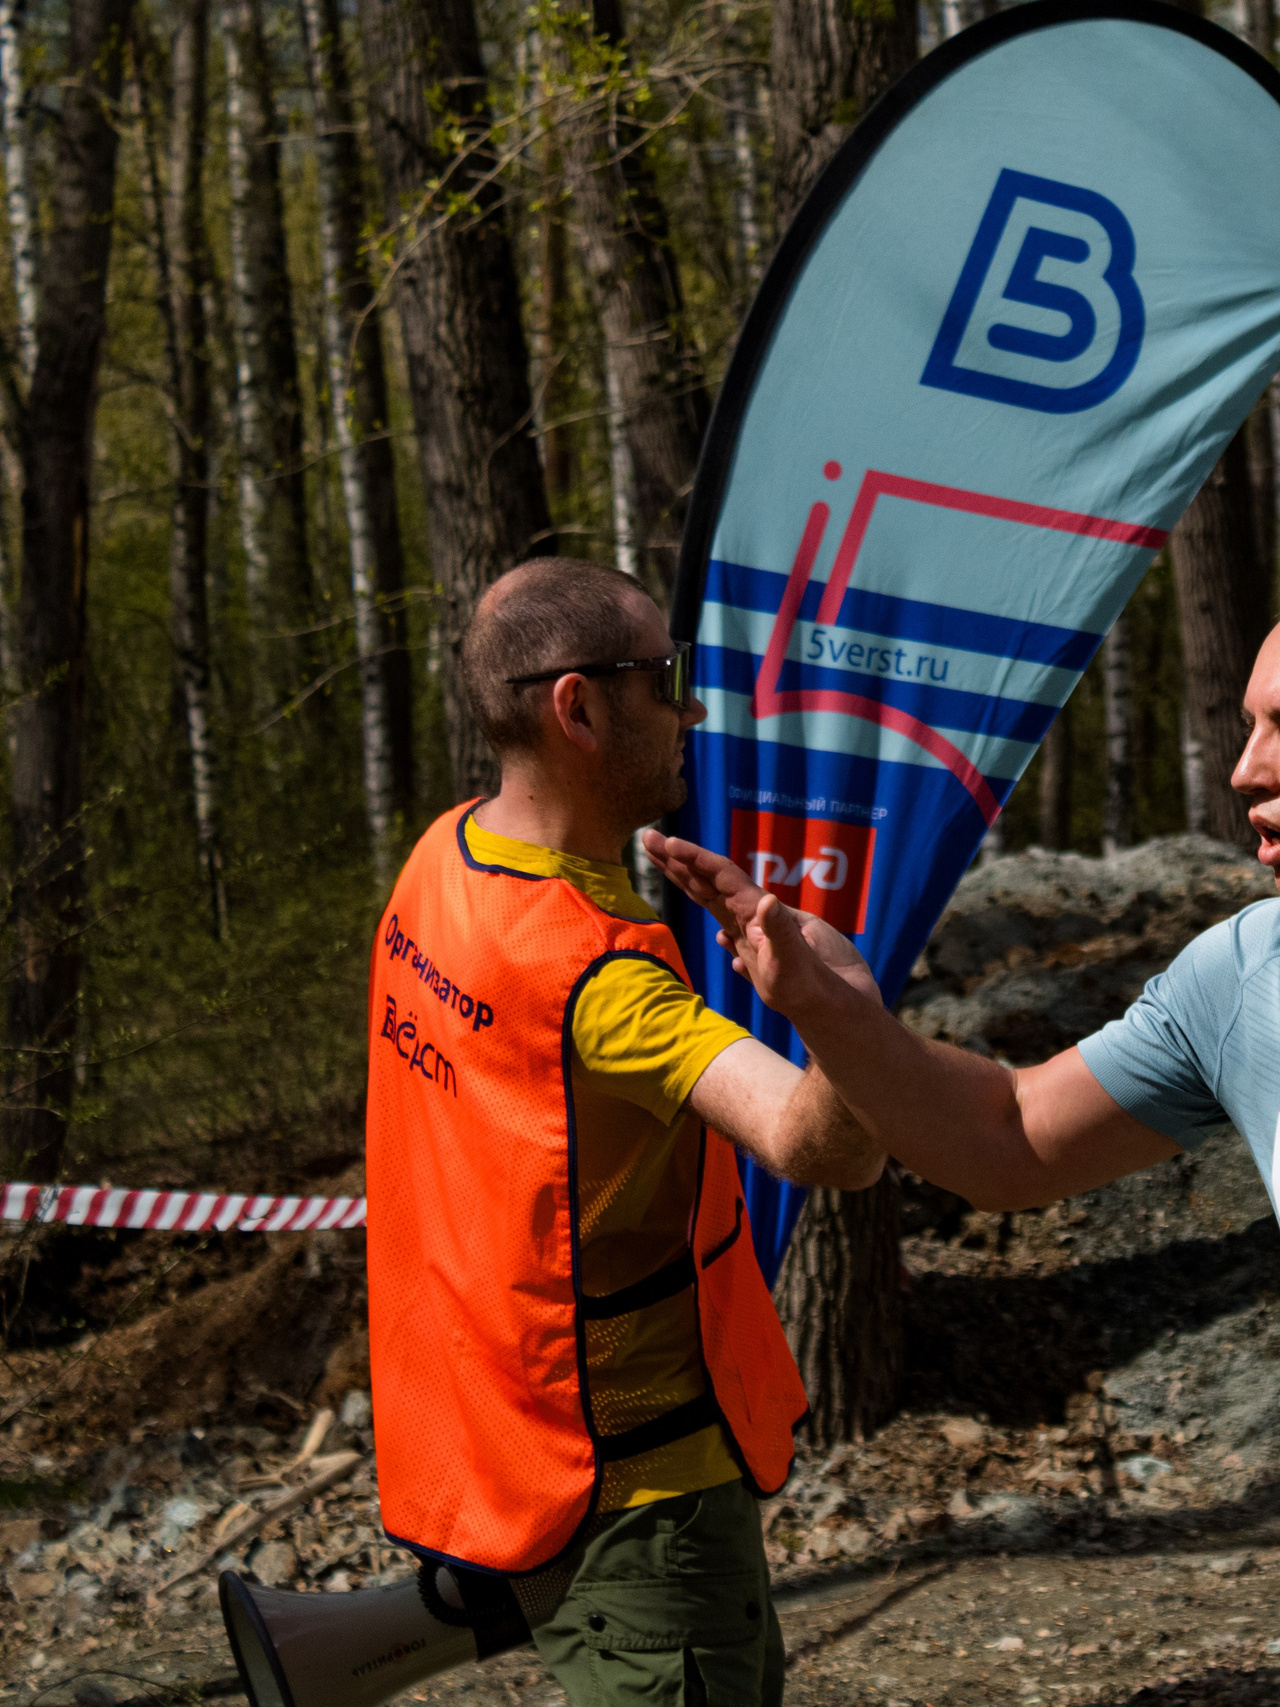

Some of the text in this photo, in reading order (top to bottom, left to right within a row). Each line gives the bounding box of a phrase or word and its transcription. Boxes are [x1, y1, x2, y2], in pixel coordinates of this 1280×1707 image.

[806, 629, 949, 683] 5verst.ru
[830, 800, 888, 820] ПАРТНЕР
[385, 913, 495, 1032] Организатор
